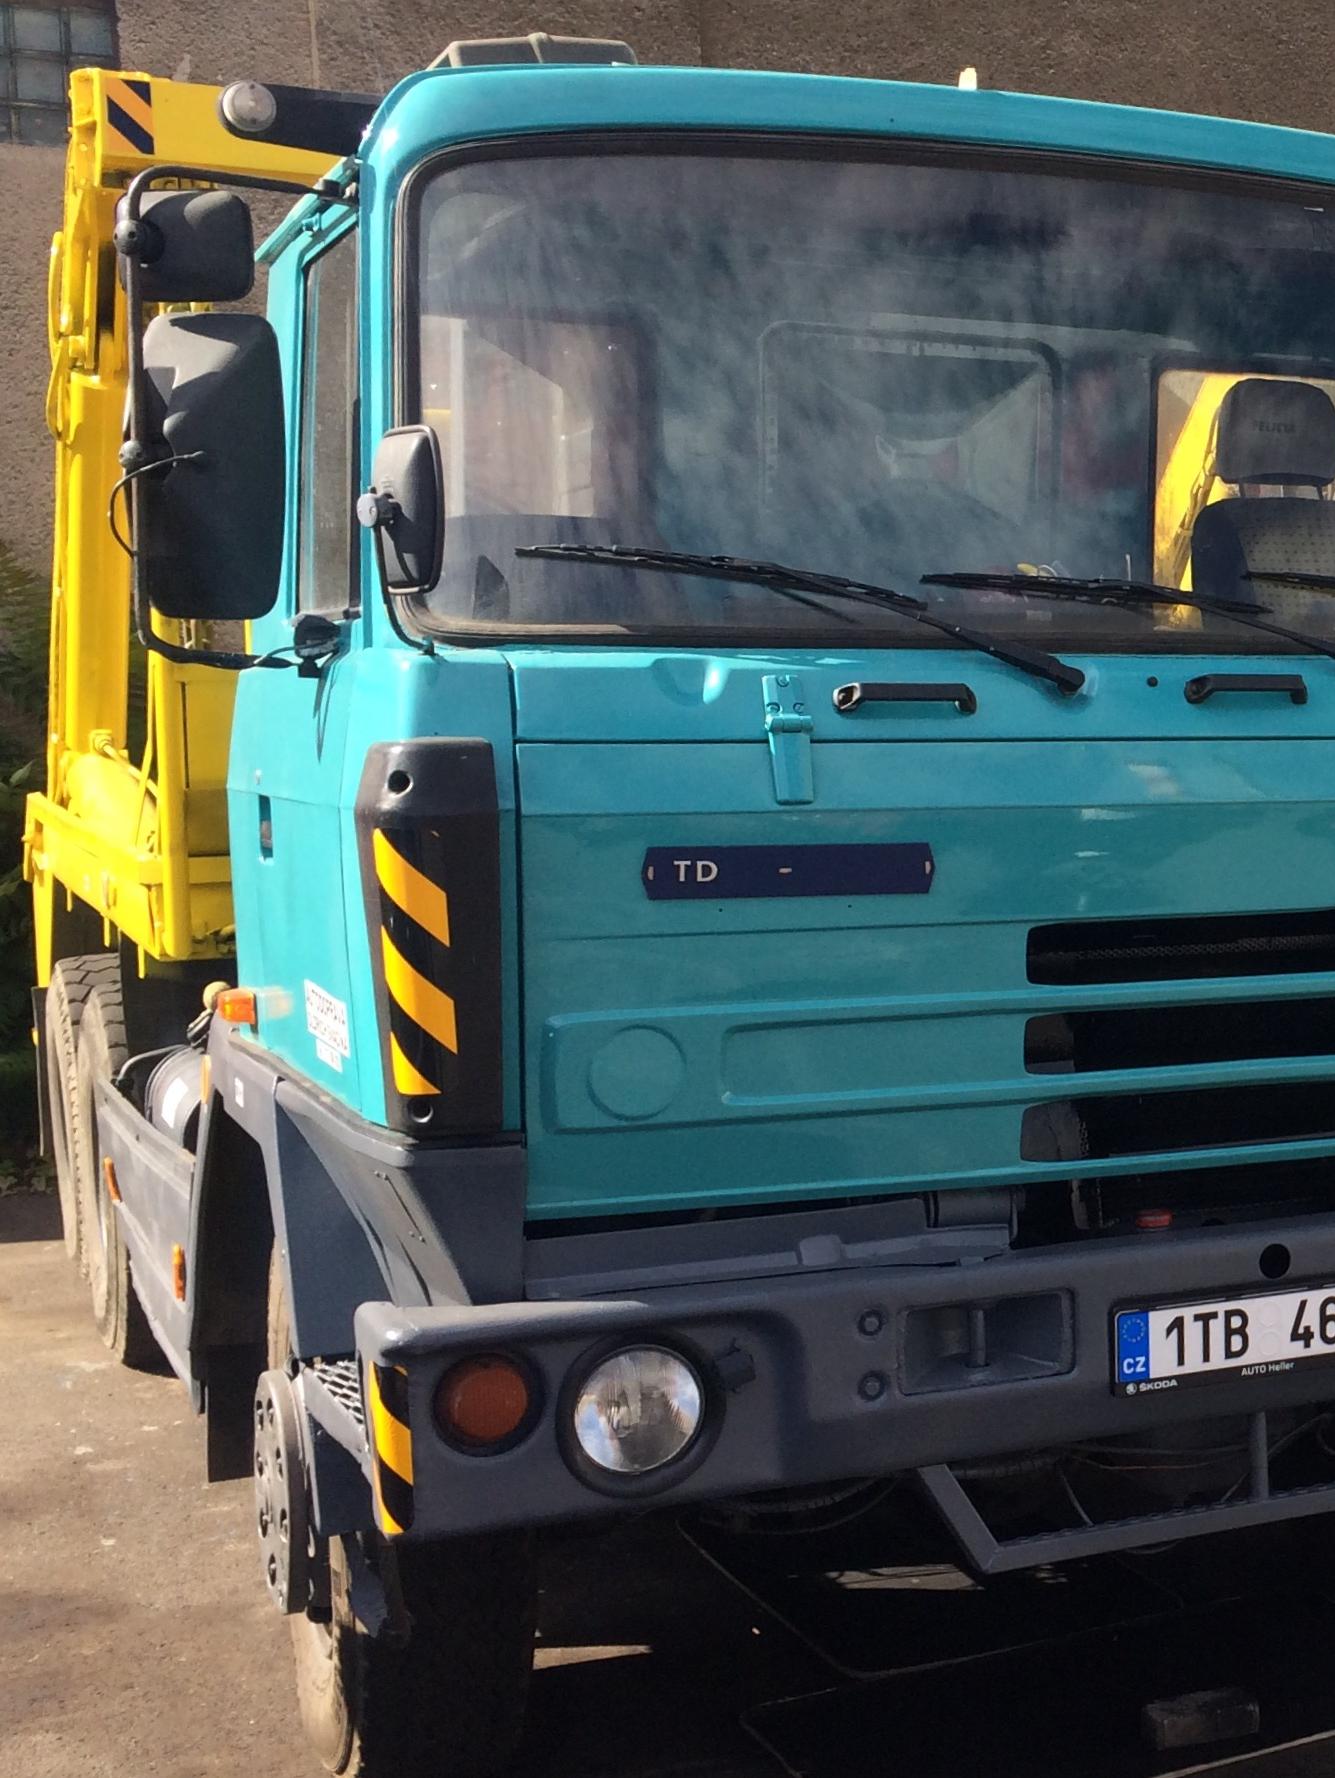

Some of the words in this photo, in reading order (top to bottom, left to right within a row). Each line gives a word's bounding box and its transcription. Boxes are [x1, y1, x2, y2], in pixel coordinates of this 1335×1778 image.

[672, 860, 719, 883] TD
[1164, 1308, 1250, 1367] 1TB
[1122, 1356, 1147, 1374] CZ
[1241, 1364, 1267, 1376] AUTO
[1268, 1361, 1295, 1373] Heller
